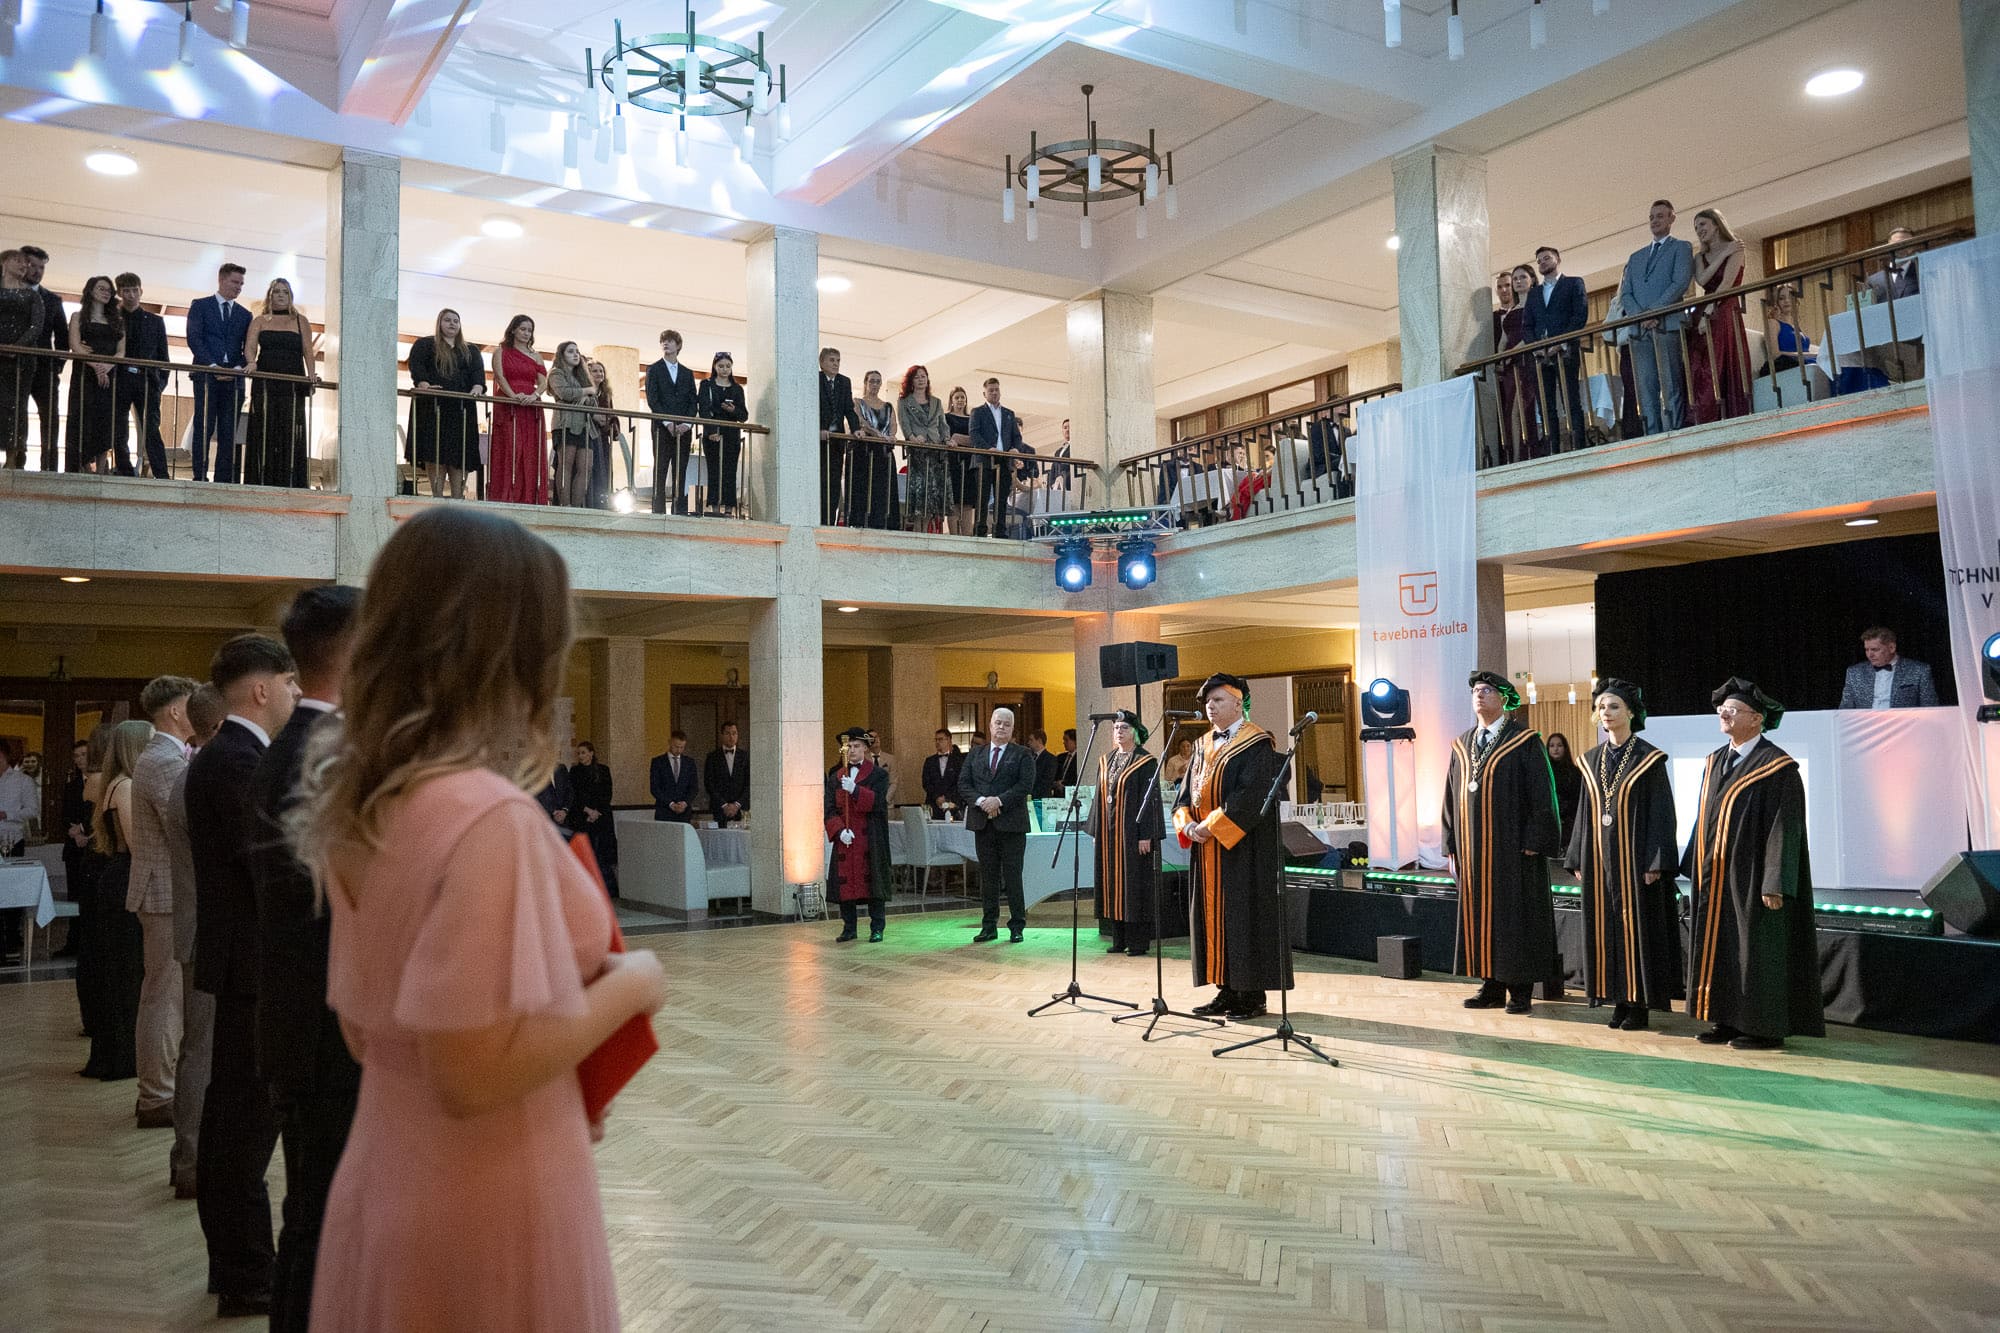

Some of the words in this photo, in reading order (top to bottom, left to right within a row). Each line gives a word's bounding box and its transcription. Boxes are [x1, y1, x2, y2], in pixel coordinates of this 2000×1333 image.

[1981, 592, 1994, 609] V
[1373, 625, 1427, 641] tavebná
[1430, 621, 1468, 637] fakulta
